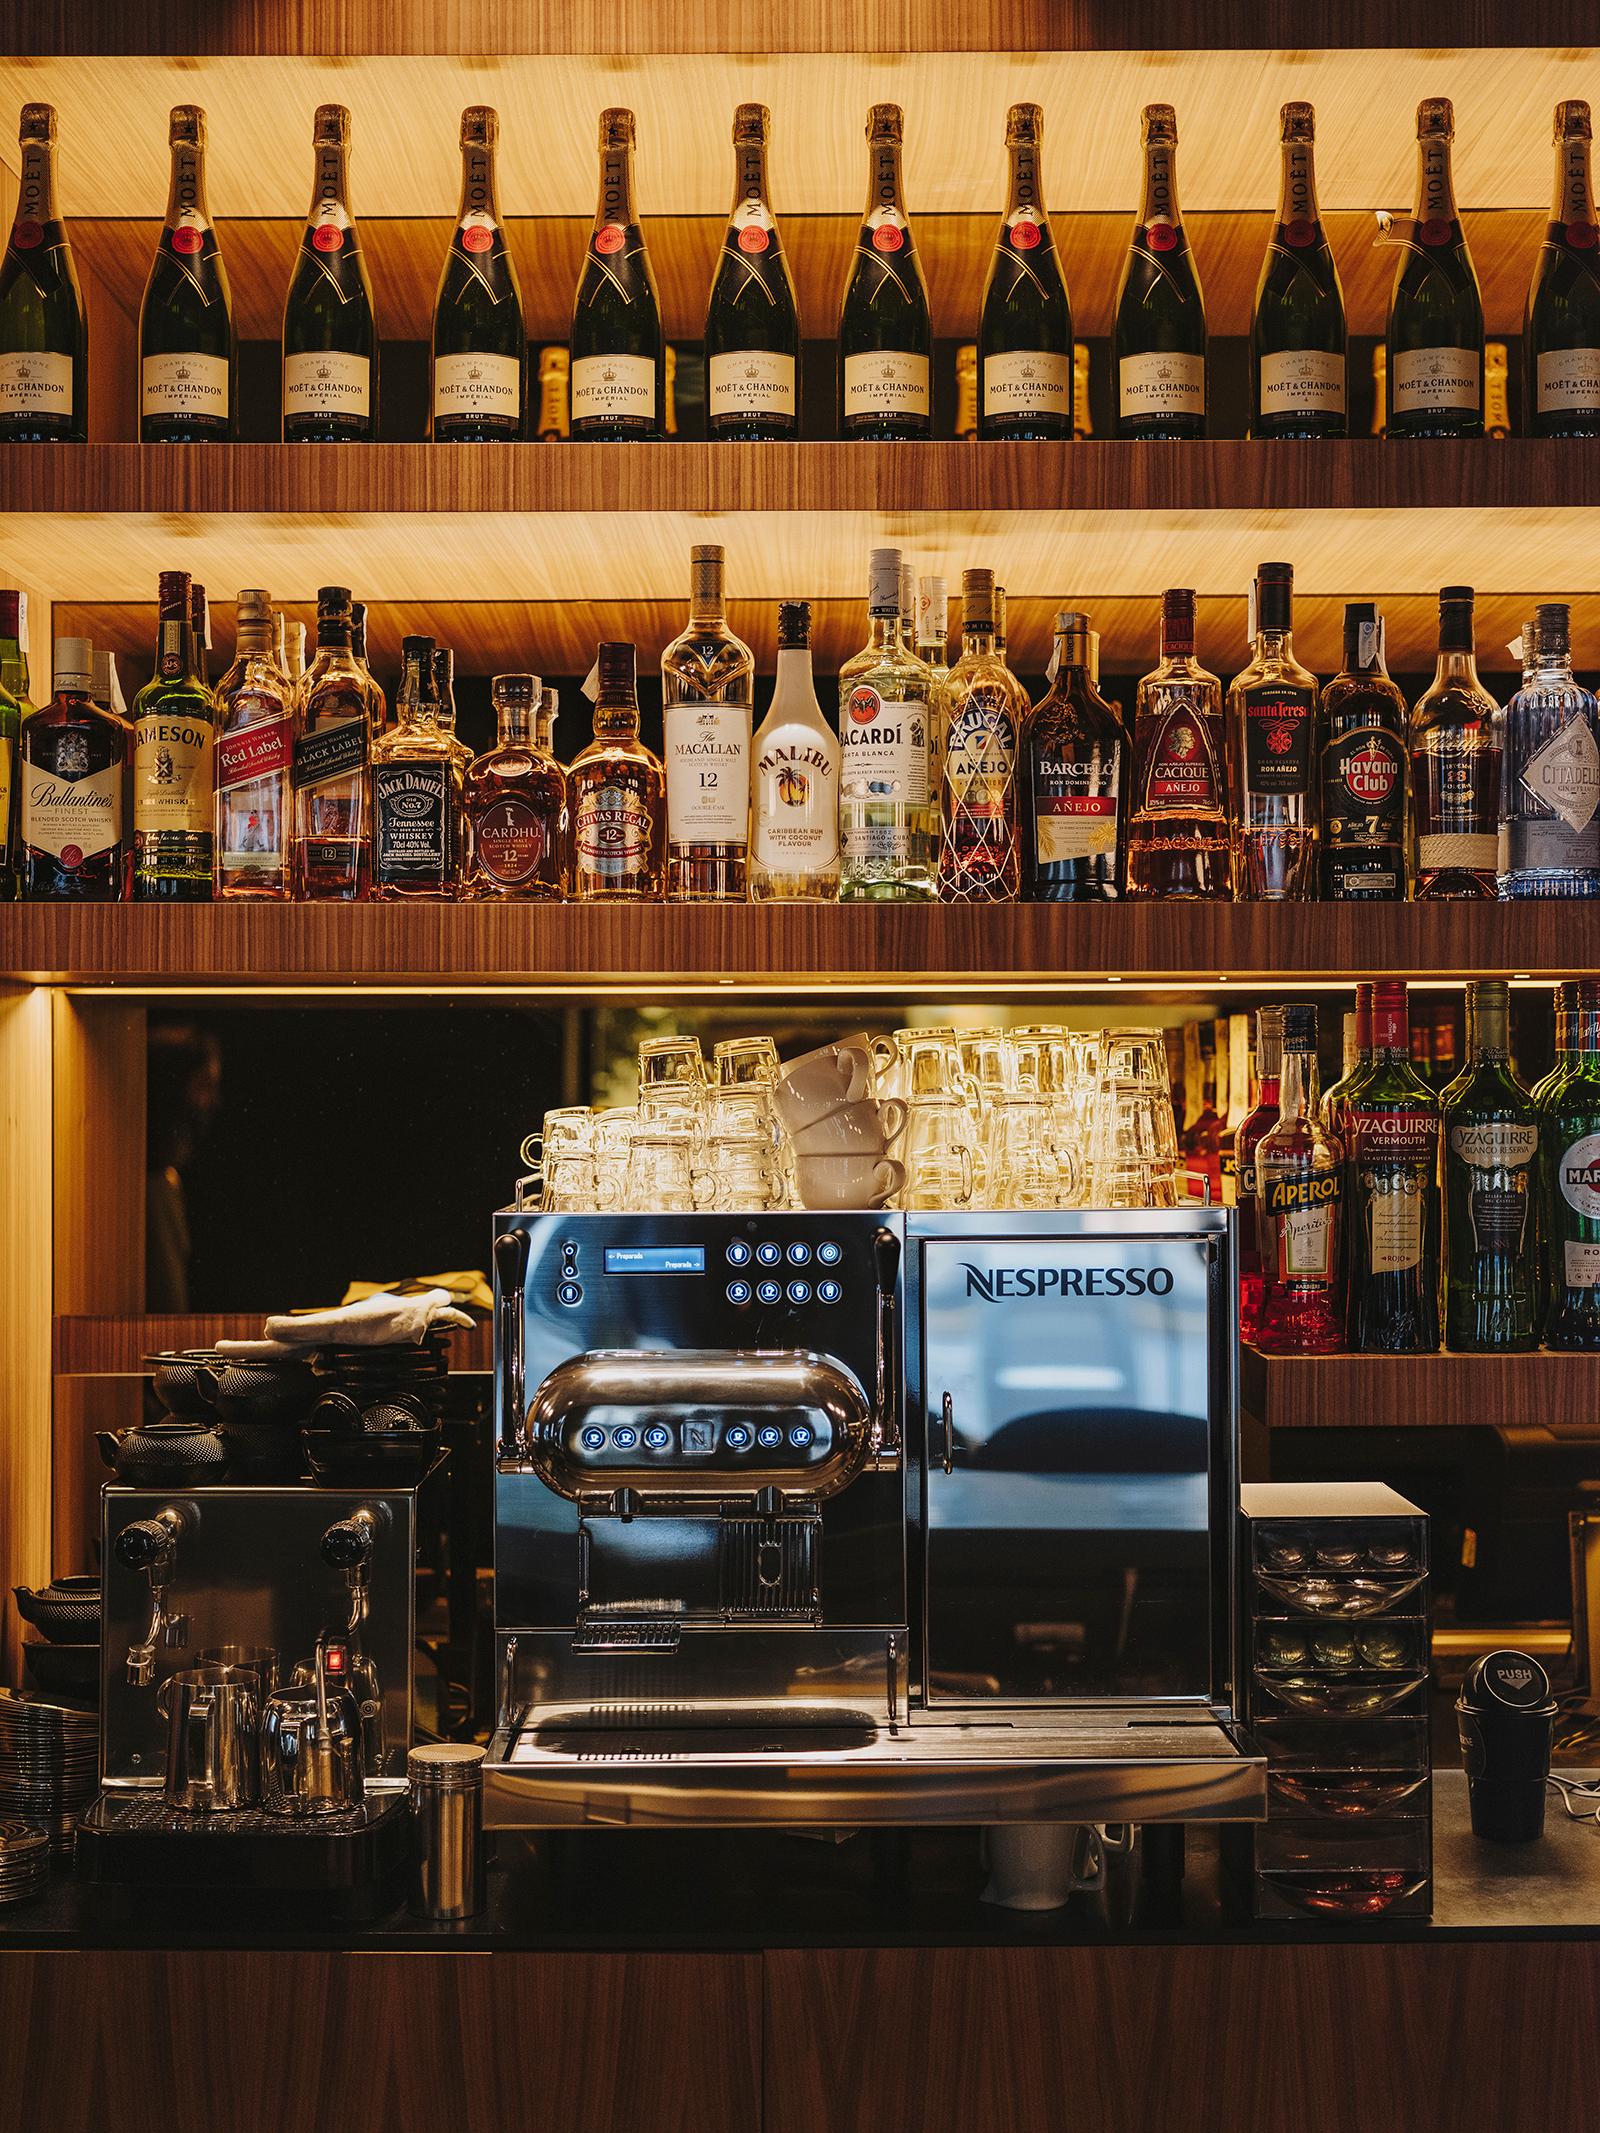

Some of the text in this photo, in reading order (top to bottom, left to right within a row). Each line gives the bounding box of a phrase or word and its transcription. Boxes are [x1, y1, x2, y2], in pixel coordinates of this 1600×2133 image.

[24, 155, 40, 216] MOËT
[181, 156, 197, 218] MOËT
[321, 156, 338, 216] MOËT
[471, 156, 486, 218] MOËT
[746, 156, 762, 217] MOËT
[880, 156, 896, 216] MOËT
[1017, 154, 1034, 216] MOËT
[1154, 156, 1169, 218] MOËT
[1292, 152, 1308, 214] MOËT
[1428, 150, 1443, 211] MOËT
[1570, 152, 1586, 214] MOËT
[604, 159, 620, 221] MOËT
[18, 383, 64, 392] CHANDON
[146, 384, 168, 396] MOËT
[178, 384, 222, 396] CHANDON
[288, 383, 309, 394] MOËT
[318, 383, 362, 394] CHANDON
[439, 384, 460, 394] MOËT
[469, 384, 514, 395] CHANDON
[576, 386, 596, 397] MOËT
[604, 386, 648, 396] CHANDON
[715, 384, 737, 394] MOËT
[746, 383, 790, 394] CHANDON
[850, 383, 874, 394] MOËT
[883, 383, 924, 394] CHANDON
[990, 384, 1013, 394] MOËT
[1022, 382, 1064, 393] CHANDON
[1126, 384, 1150, 396] MOËT
[1159, 384, 1200, 393] CHANDON
[1267, 382, 1291, 393] MOËT
[1300, 382, 1341, 391] CHANDON
[1398, 380, 1422, 391] MOËT
[1431, 379, 1474, 388] CHANDON
[1544, 381, 1570, 391] MOËT
[702, 646, 713, 655] 12
[699, 730, 715, 742] The
[950, 712, 1012, 749] BRUGAL
[221, 736, 284, 768] Red Label
[296, 736, 364, 766] BLACK LABEL
[675, 743, 742, 755] MACALLAN
[758, 746, 832, 777] MALIBU
[956, 758, 1008, 774] AÑEJO
[1339, 758, 1398, 776] Havana
[699, 772, 718, 788] 12
[1155, 767, 1209, 778] CACIQUE
[378, 777, 405, 800] JACK
[1166, 782, 1200, 792] AÑEJO
[1353, 775, 1388, 791] Club
[1053, 801, 1101, 812] AÑEJO
[388, 817, 435, 827] Tennessee
[577, 811, 648, 829] CHIVAS REGAL
[1365, 816, 1379, 834] 7
[606, 829, 617, 840] 12
[324, 849, 334, 858] 12
[503, 850, 518, 862] 12
[1352, 1116, 1438, 1138] YZAGUIRRE
[1372, 1136, 1426, 1145] VERMOUTH
[1458, 1130, 1534, 1147] YZAGUIRRE
[1465, 1146, 1529, 1154] BLANCO RESERVA
[1272, 1177, 1340, 1207] APEROL
[956, 1262, 1174, 1304] NESPRESSO
[1497, 1669, 1532, 1679] PUSH
